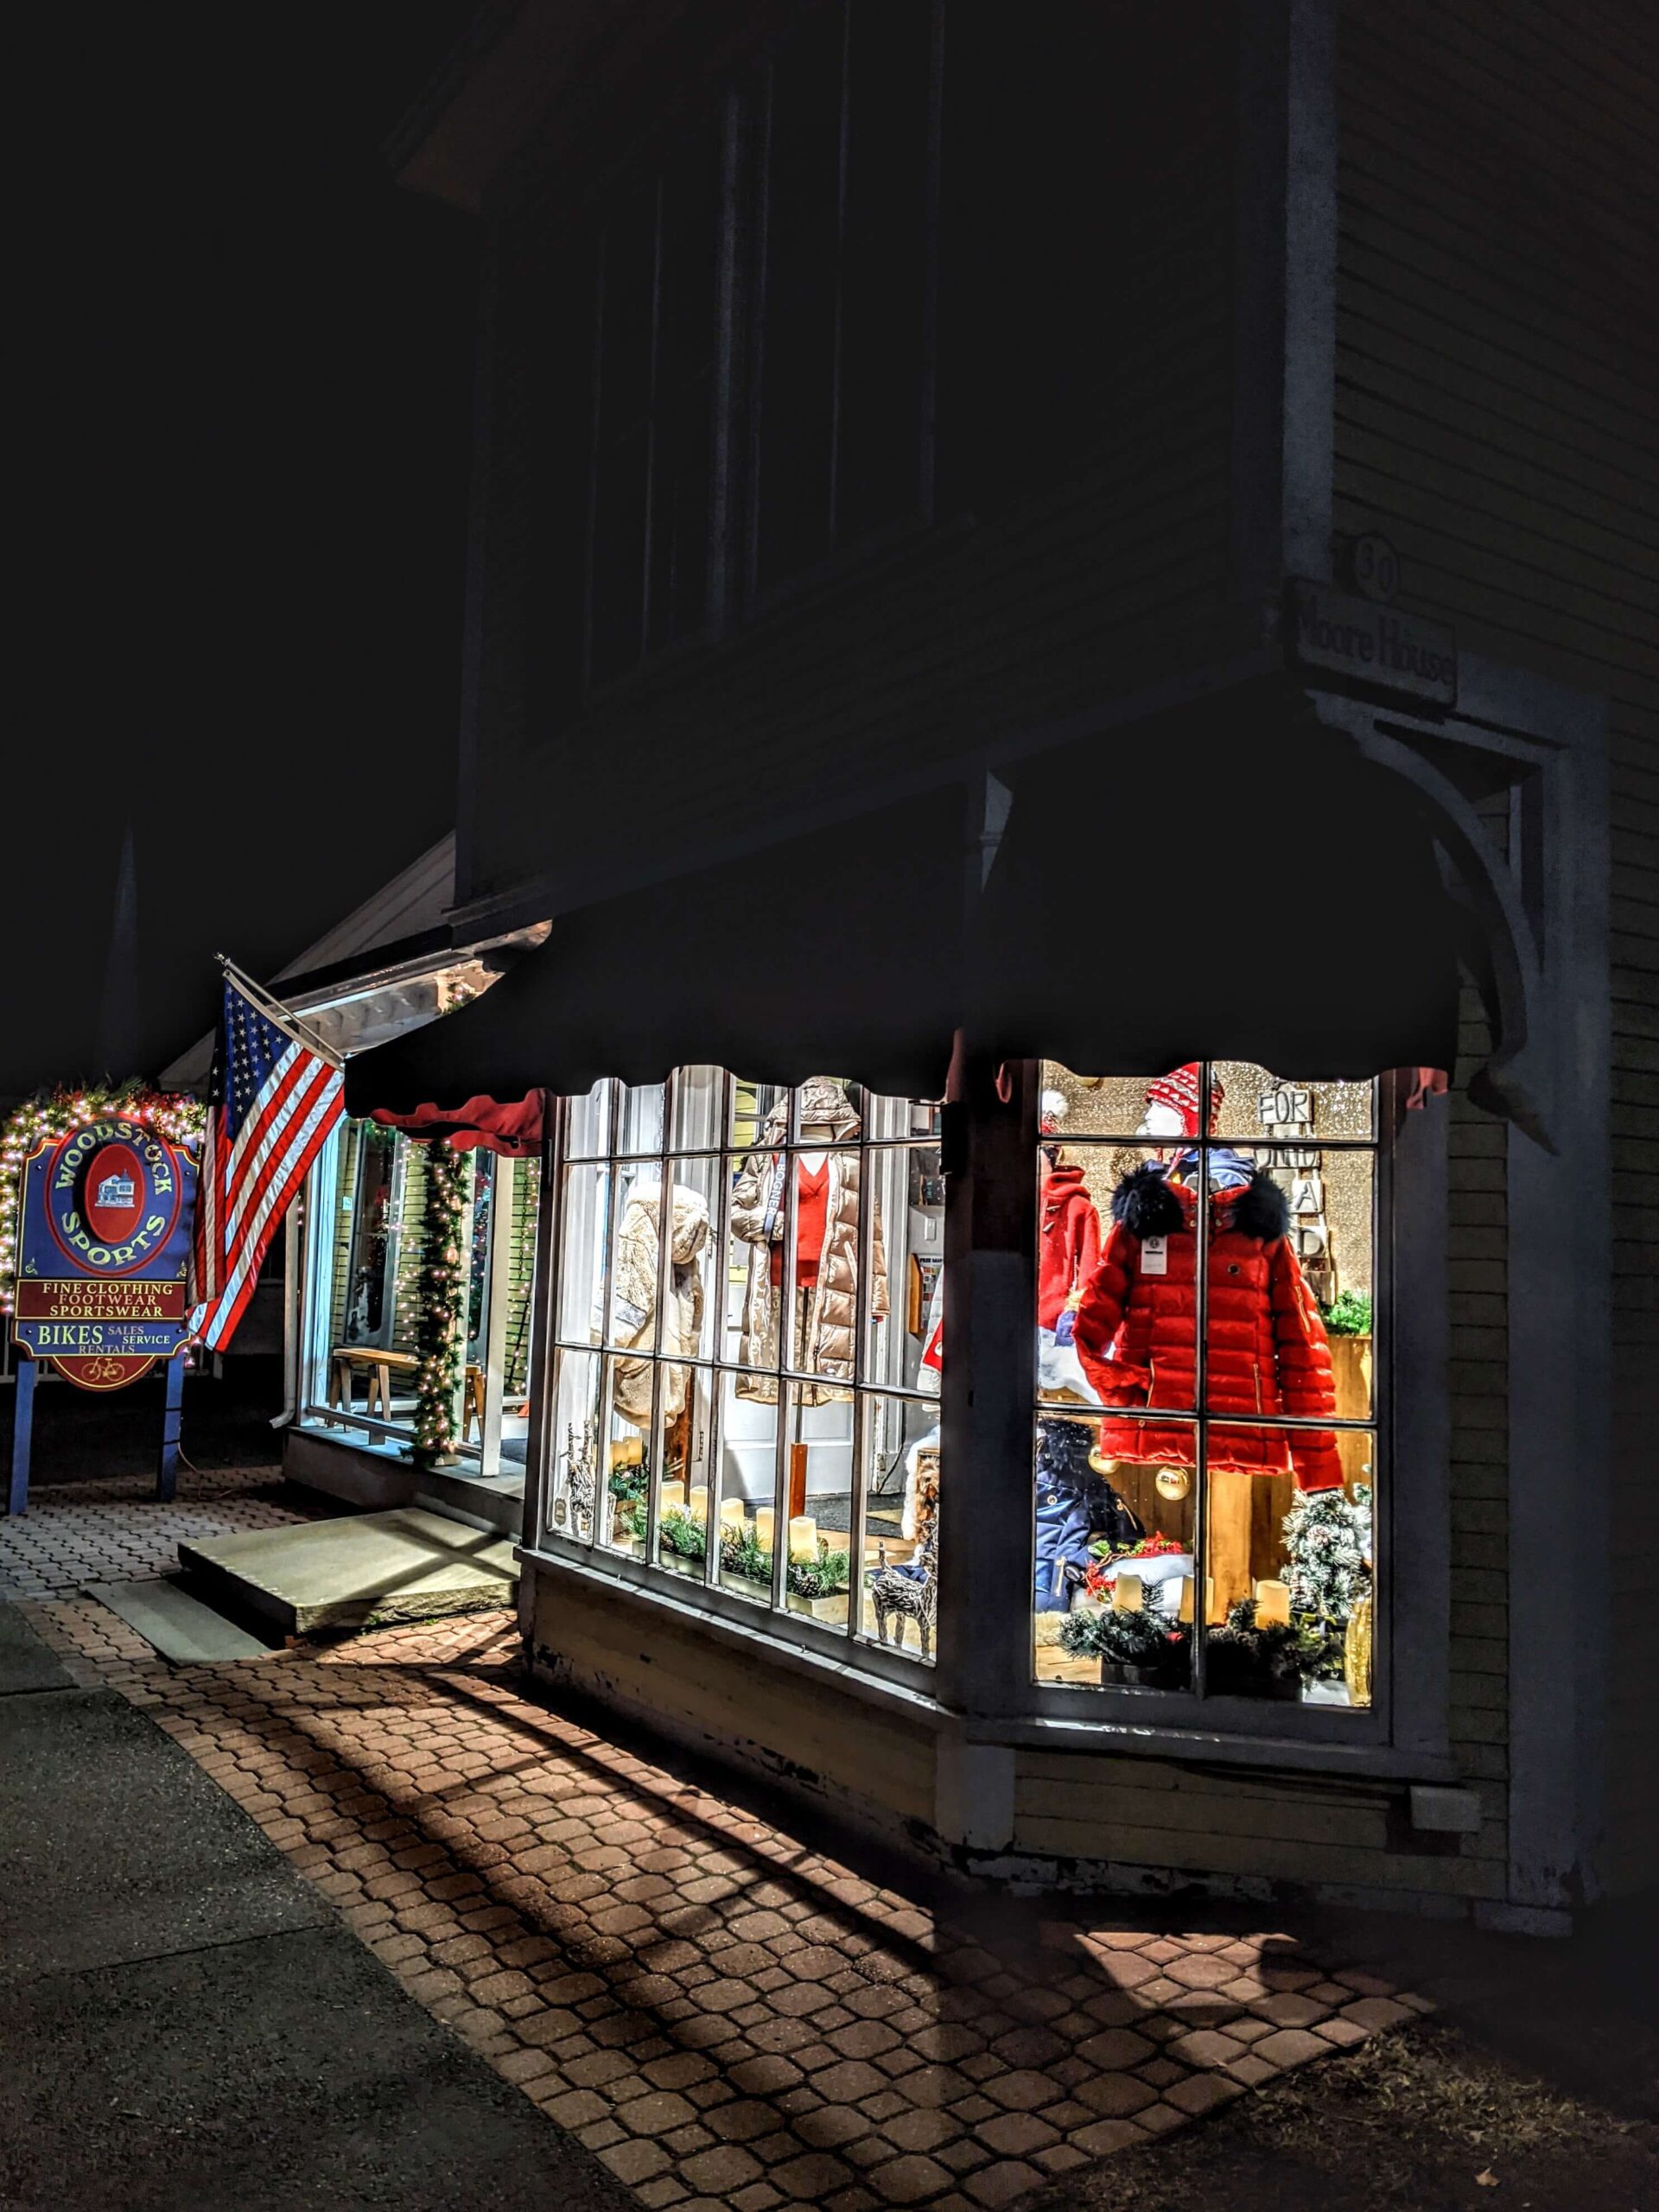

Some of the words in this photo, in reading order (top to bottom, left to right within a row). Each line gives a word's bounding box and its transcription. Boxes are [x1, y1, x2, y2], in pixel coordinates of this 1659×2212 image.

[1259, 1090, 1308, 1123] FOR
[55, 1122, 173, 1196] WOODSTOCK
[766, 1164, 785, 1217] BOGNER
[61, 1211, 166, 1267] SPORTS
[42, 1282, 82, 1294] FINE
[86, 1283, 174, 1295] CLOTHING
[59, 1294, 157, 1306] FOOTWEAR
[50, 1306, 163, 1317] SPORTSWEAR
[37, 1325, 103, 1345] BIKES
[107, 1325, 144, 1336] SALES
[123, 1335, 171, 1344] SERVICE
[79, 1344, 136, 1355] RENTALS
